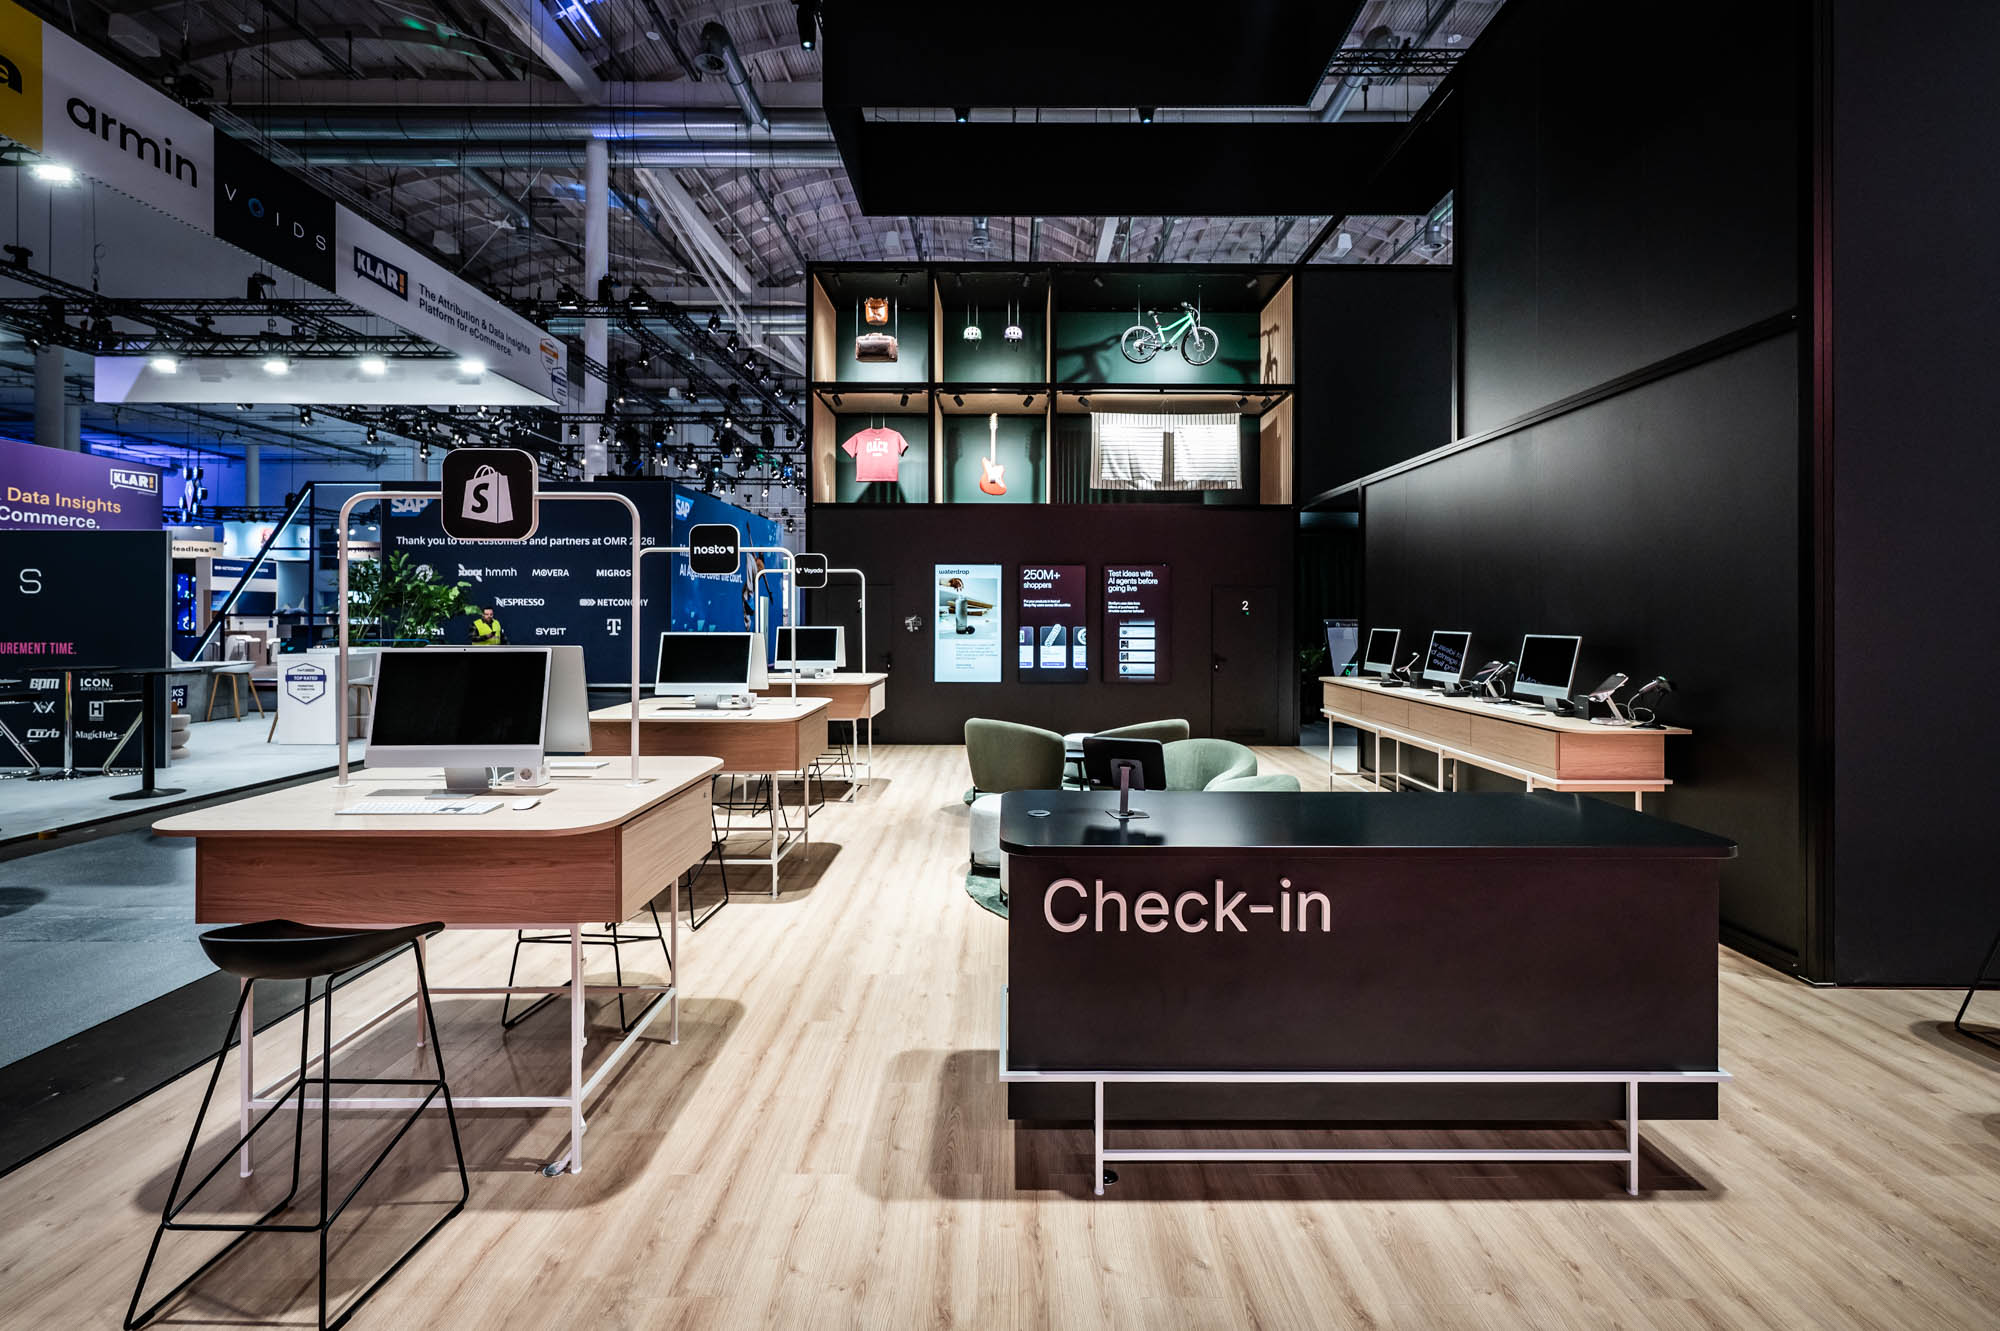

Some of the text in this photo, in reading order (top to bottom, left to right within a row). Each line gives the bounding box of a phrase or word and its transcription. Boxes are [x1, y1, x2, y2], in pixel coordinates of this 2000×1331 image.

[66, 97, 197, 188] armin
[225, 183, 326, 251] VOIDS
[356, 253, 405, 294] KLAR!
[418, 283, 531, 356] The Attribution & Data Insights
[419, 298, 513, 357] Platform for eCommerce.
[113, 472, 154, 489] KLAR!
[7, 486, 122, 514] Data Insights
[391, 498, 429, 513] SAP
[676, 499, 690, 517] SAP
[0, 506, 100, 529] Commerce.
[396, 536, 425, 546] Thank
[427, 538, 446, 548] you
[447, 537, 457, 545] to
[529, 536, 547, 546] and
[550, 537, 590, 547] partners
[592, 537, 601, 546] at
[603, 536, 627, 546] OMR
[629, 536, 655, 546] 226!
[693, 544, 726, 555] nosto
[485, 568, 517, 577] hmmh
[532, 569, 569, 577] MOVERA
[596, 569, 631, 577] MIGROS
[1023, 569, 1060, 580] 250M+
[19, 568, 42, 594] S
[1023, 581, 1052, 589] shoppers
[1116, 578, 1137, 586] agents
[1108, 585, 1126, 593] going
[494, 596, 545, 607] NESPRESSO
[1241, 600, 1249, 611] 2
[535, 627, 566, 636] SYBIT
[0, 642, 77, 655] UREMENT TIME.
[80, 678, 113, 687] ICON.
[1043, 877, 1331, 933] Check-in
